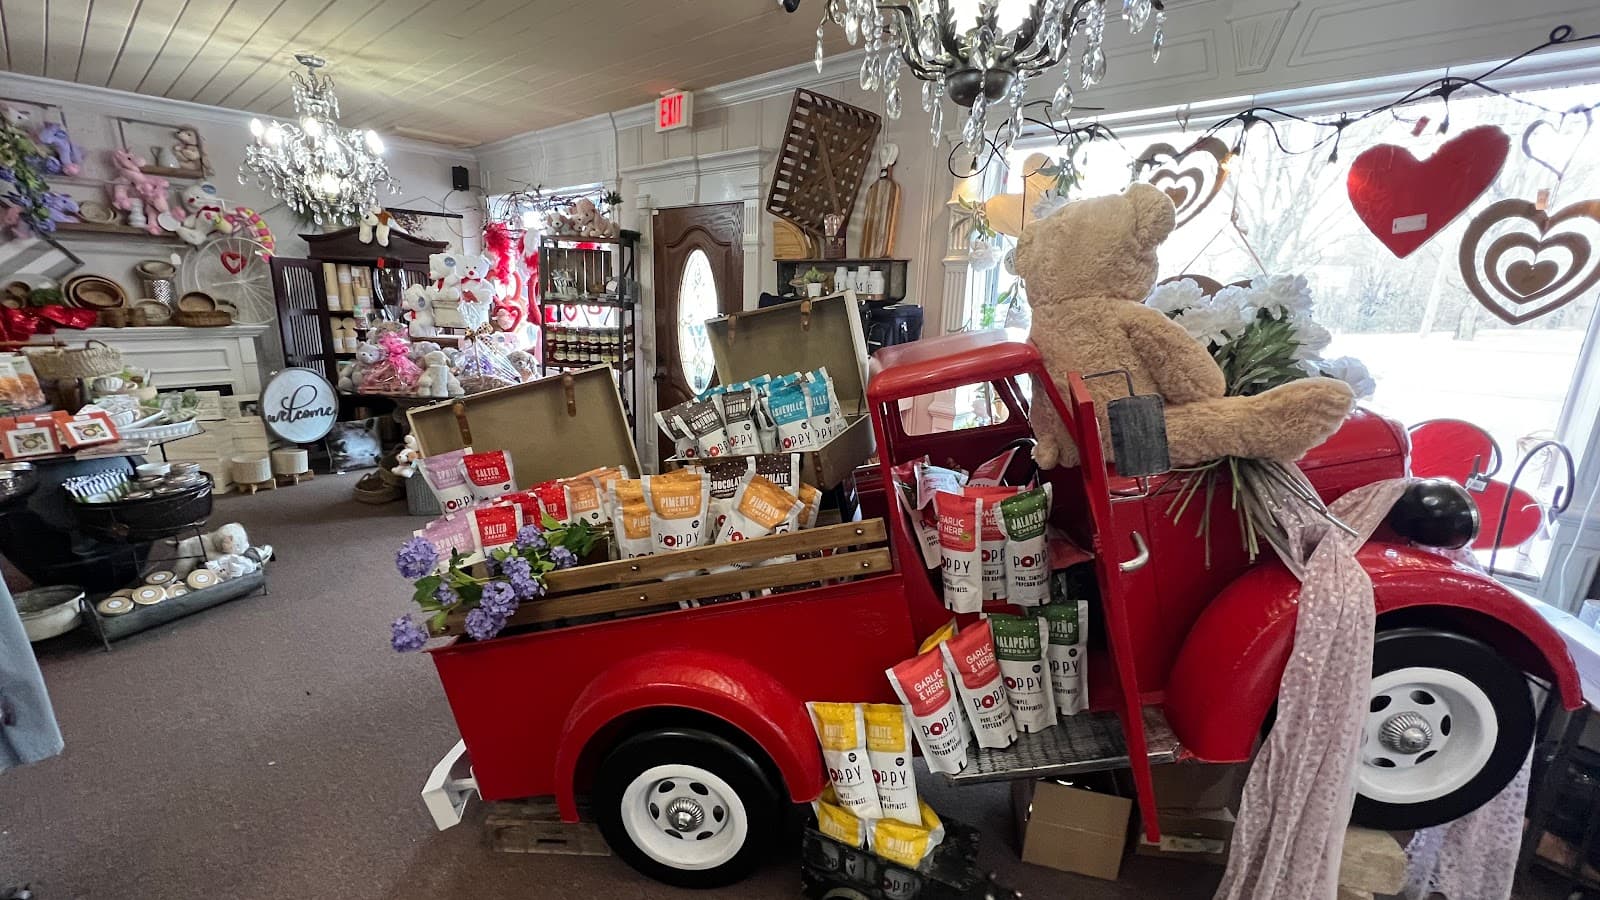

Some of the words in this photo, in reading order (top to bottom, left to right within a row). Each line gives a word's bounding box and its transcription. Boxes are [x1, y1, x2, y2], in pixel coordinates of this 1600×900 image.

[661, 95, 683, 128] EXIT
[267, 384, 337, 423] welcome
[730, 434, 754, 447] OPPY
[475, 466, 500, 478] SALTED
[660, 495, 694, 509] PIMENTO
[748, 495, 780, 519] PIMENTO
[484, 523, 507, 536] SALTED
[633, 514, 651, 529] PIME
[943, 524, 964, 536] HERB
[940, 555, 970, 574] OPPY
[1013, 549, 1047, 569] POPP
[966, 642, 992, 665] GARLIC
[970, 664, 978, 673] &
[976, 652, 994, 670] HERB
[914, 668, 943, 692] GARLIC
[1003, 675, 1043, 691] OPPY
[918, 691, 926, 701] &
[973, 684, 1005, 711] POPP
[922, 710, 956, 738] POPP
[829, 765, 862, 784] OPPY
[871, 769, 907, 787] OPPY
